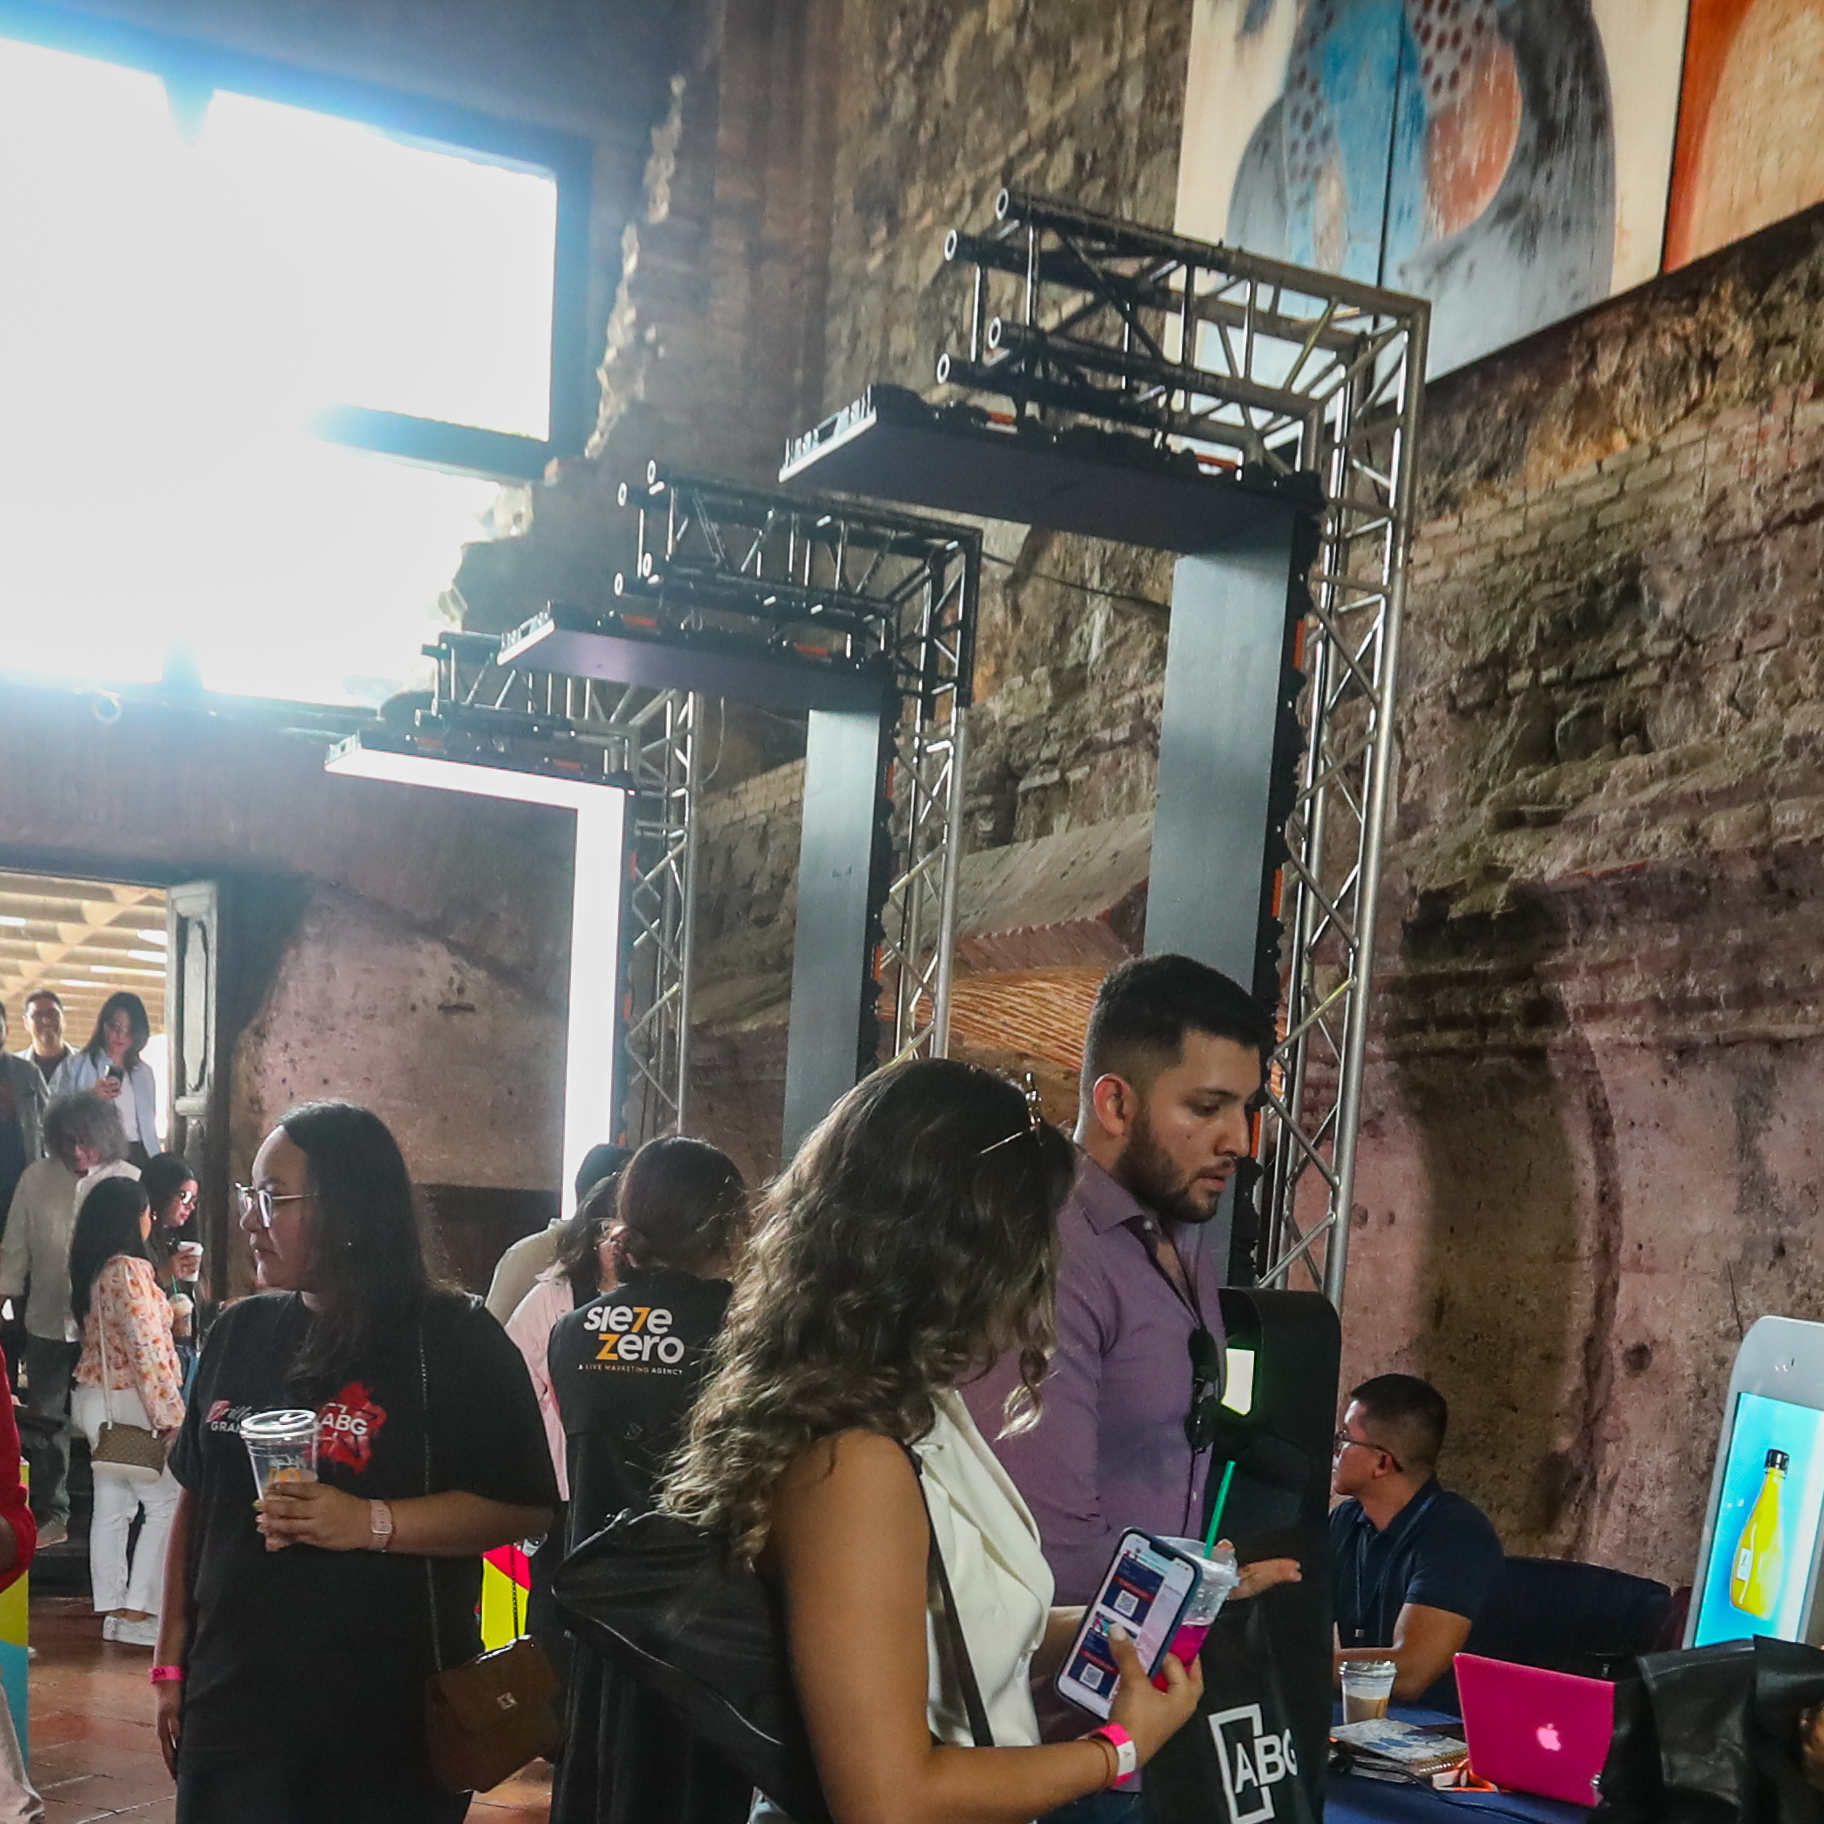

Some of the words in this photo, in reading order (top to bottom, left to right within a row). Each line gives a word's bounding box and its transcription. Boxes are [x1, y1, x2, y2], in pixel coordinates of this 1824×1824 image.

[604, 1364, 649, 1373] MARKETING
[651, 1366, 683, 1375] AGENCY
[211, 1420, 241, 1433] GRA
[322, 1413, 368, 1435] ABG
[1235, 1728, 1298, 1794] ABG
